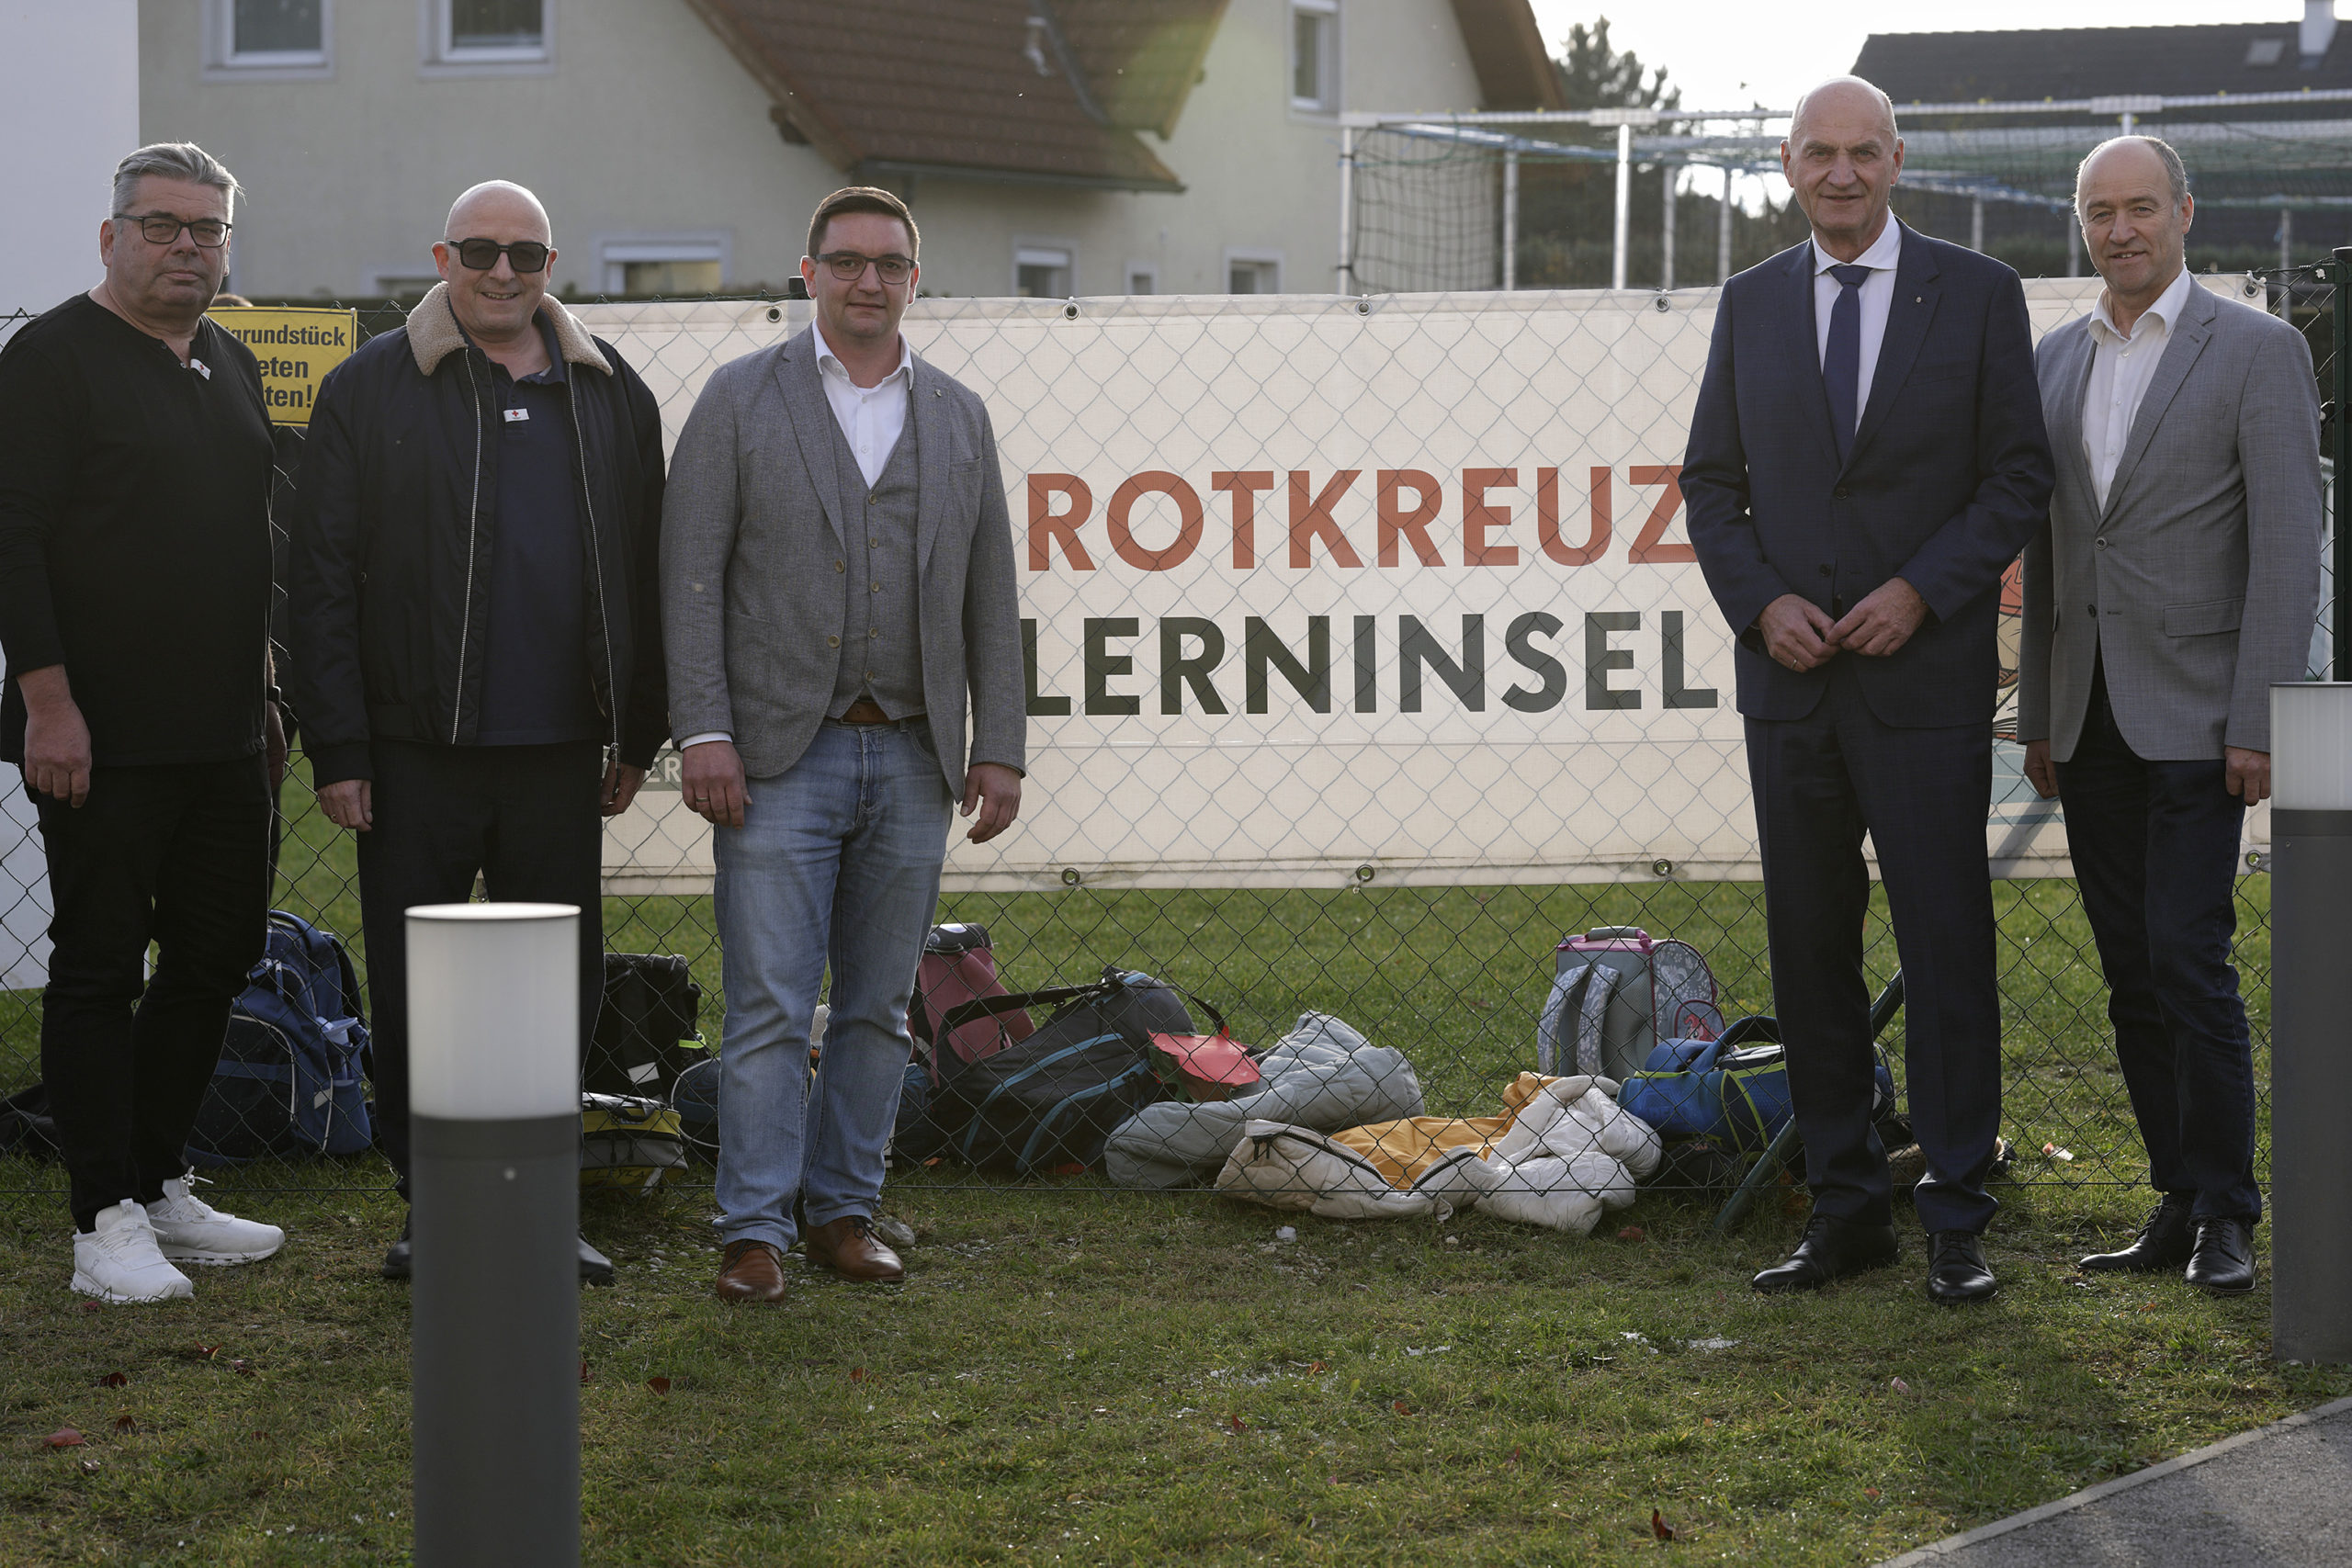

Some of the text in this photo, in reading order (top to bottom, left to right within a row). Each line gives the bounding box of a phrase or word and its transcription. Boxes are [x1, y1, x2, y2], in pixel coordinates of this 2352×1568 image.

[227, 324, 345, 346] rundstück
[1026, 465, 1700, 571] ROTKREUZ
[1019, 610, 1718, 716] LERNINSEL
